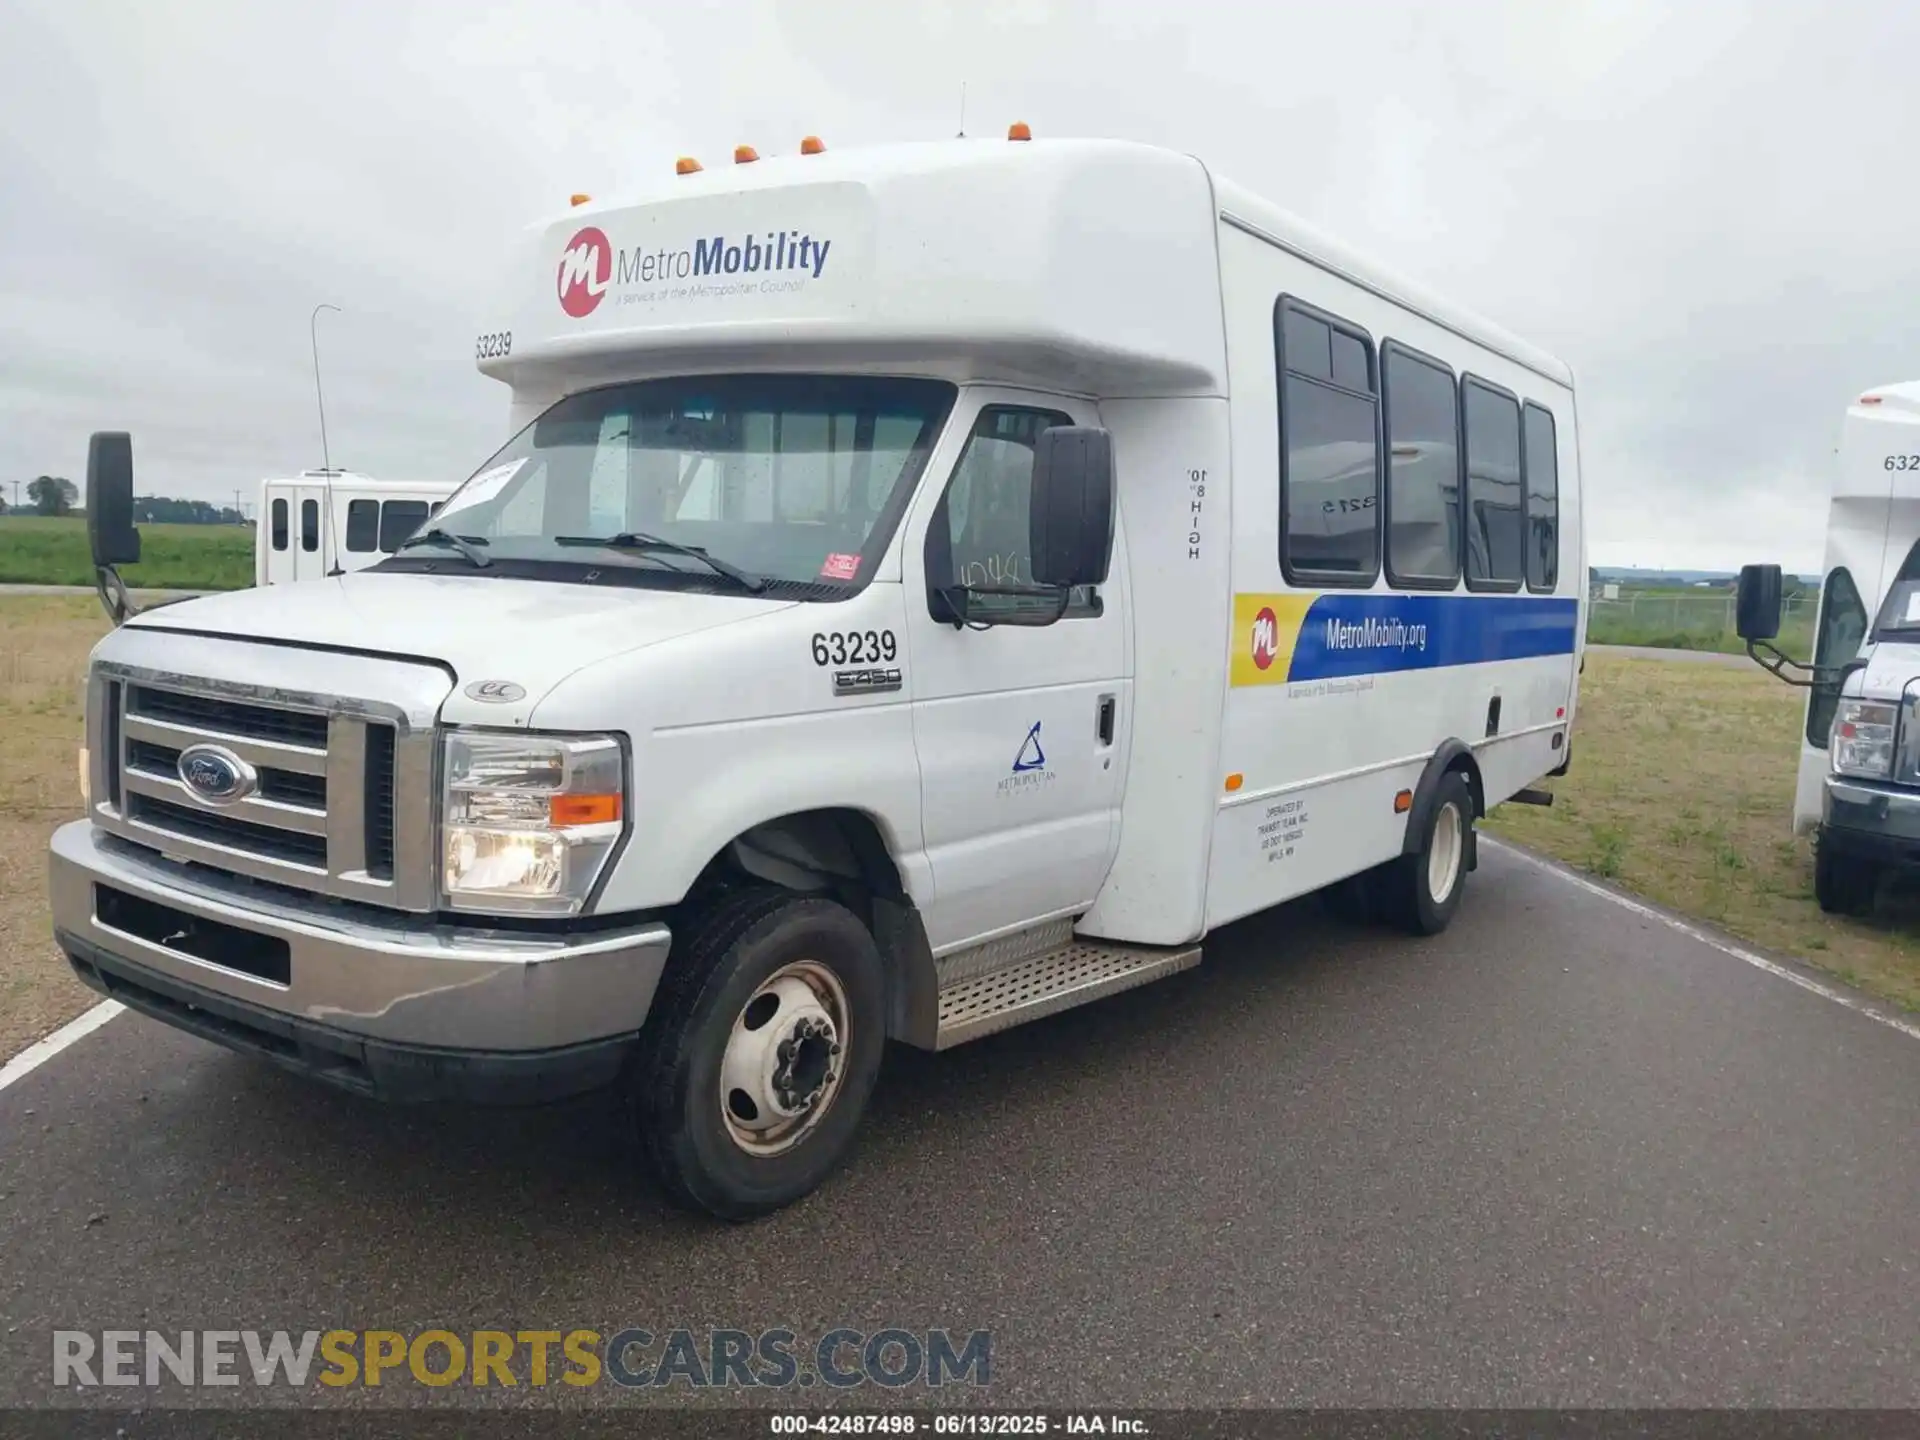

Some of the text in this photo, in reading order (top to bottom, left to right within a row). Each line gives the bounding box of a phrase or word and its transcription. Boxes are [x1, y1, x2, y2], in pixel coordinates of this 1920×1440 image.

[616, 231, 831, 284] MetroMobility
[1884, 455, 1920, 471] 632
[811, 629, 897, 666] 63239
[1326, 617, 1427, 652] MetroMobility.org
[189, 759, 224, 786] Ford
